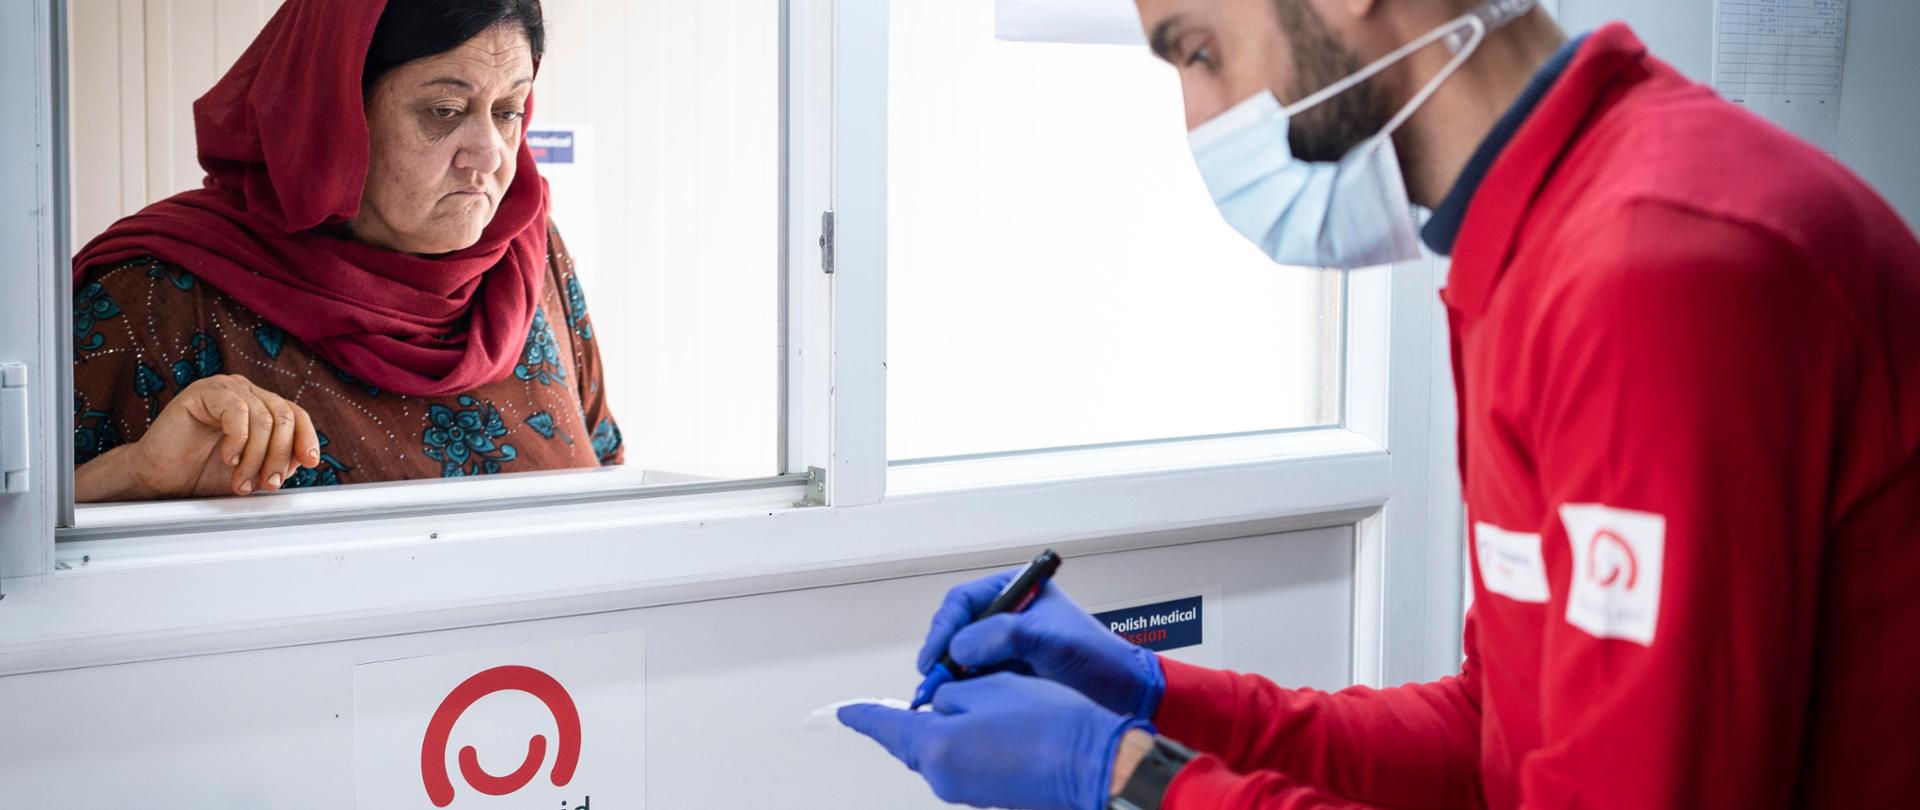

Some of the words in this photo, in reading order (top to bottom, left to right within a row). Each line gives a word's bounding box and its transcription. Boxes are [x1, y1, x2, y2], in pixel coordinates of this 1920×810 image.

[1110, 616, 1147, 633] Polish
[1150, 606, 1196, 627] Medical
[1119, 628, 1167, 644] ission
